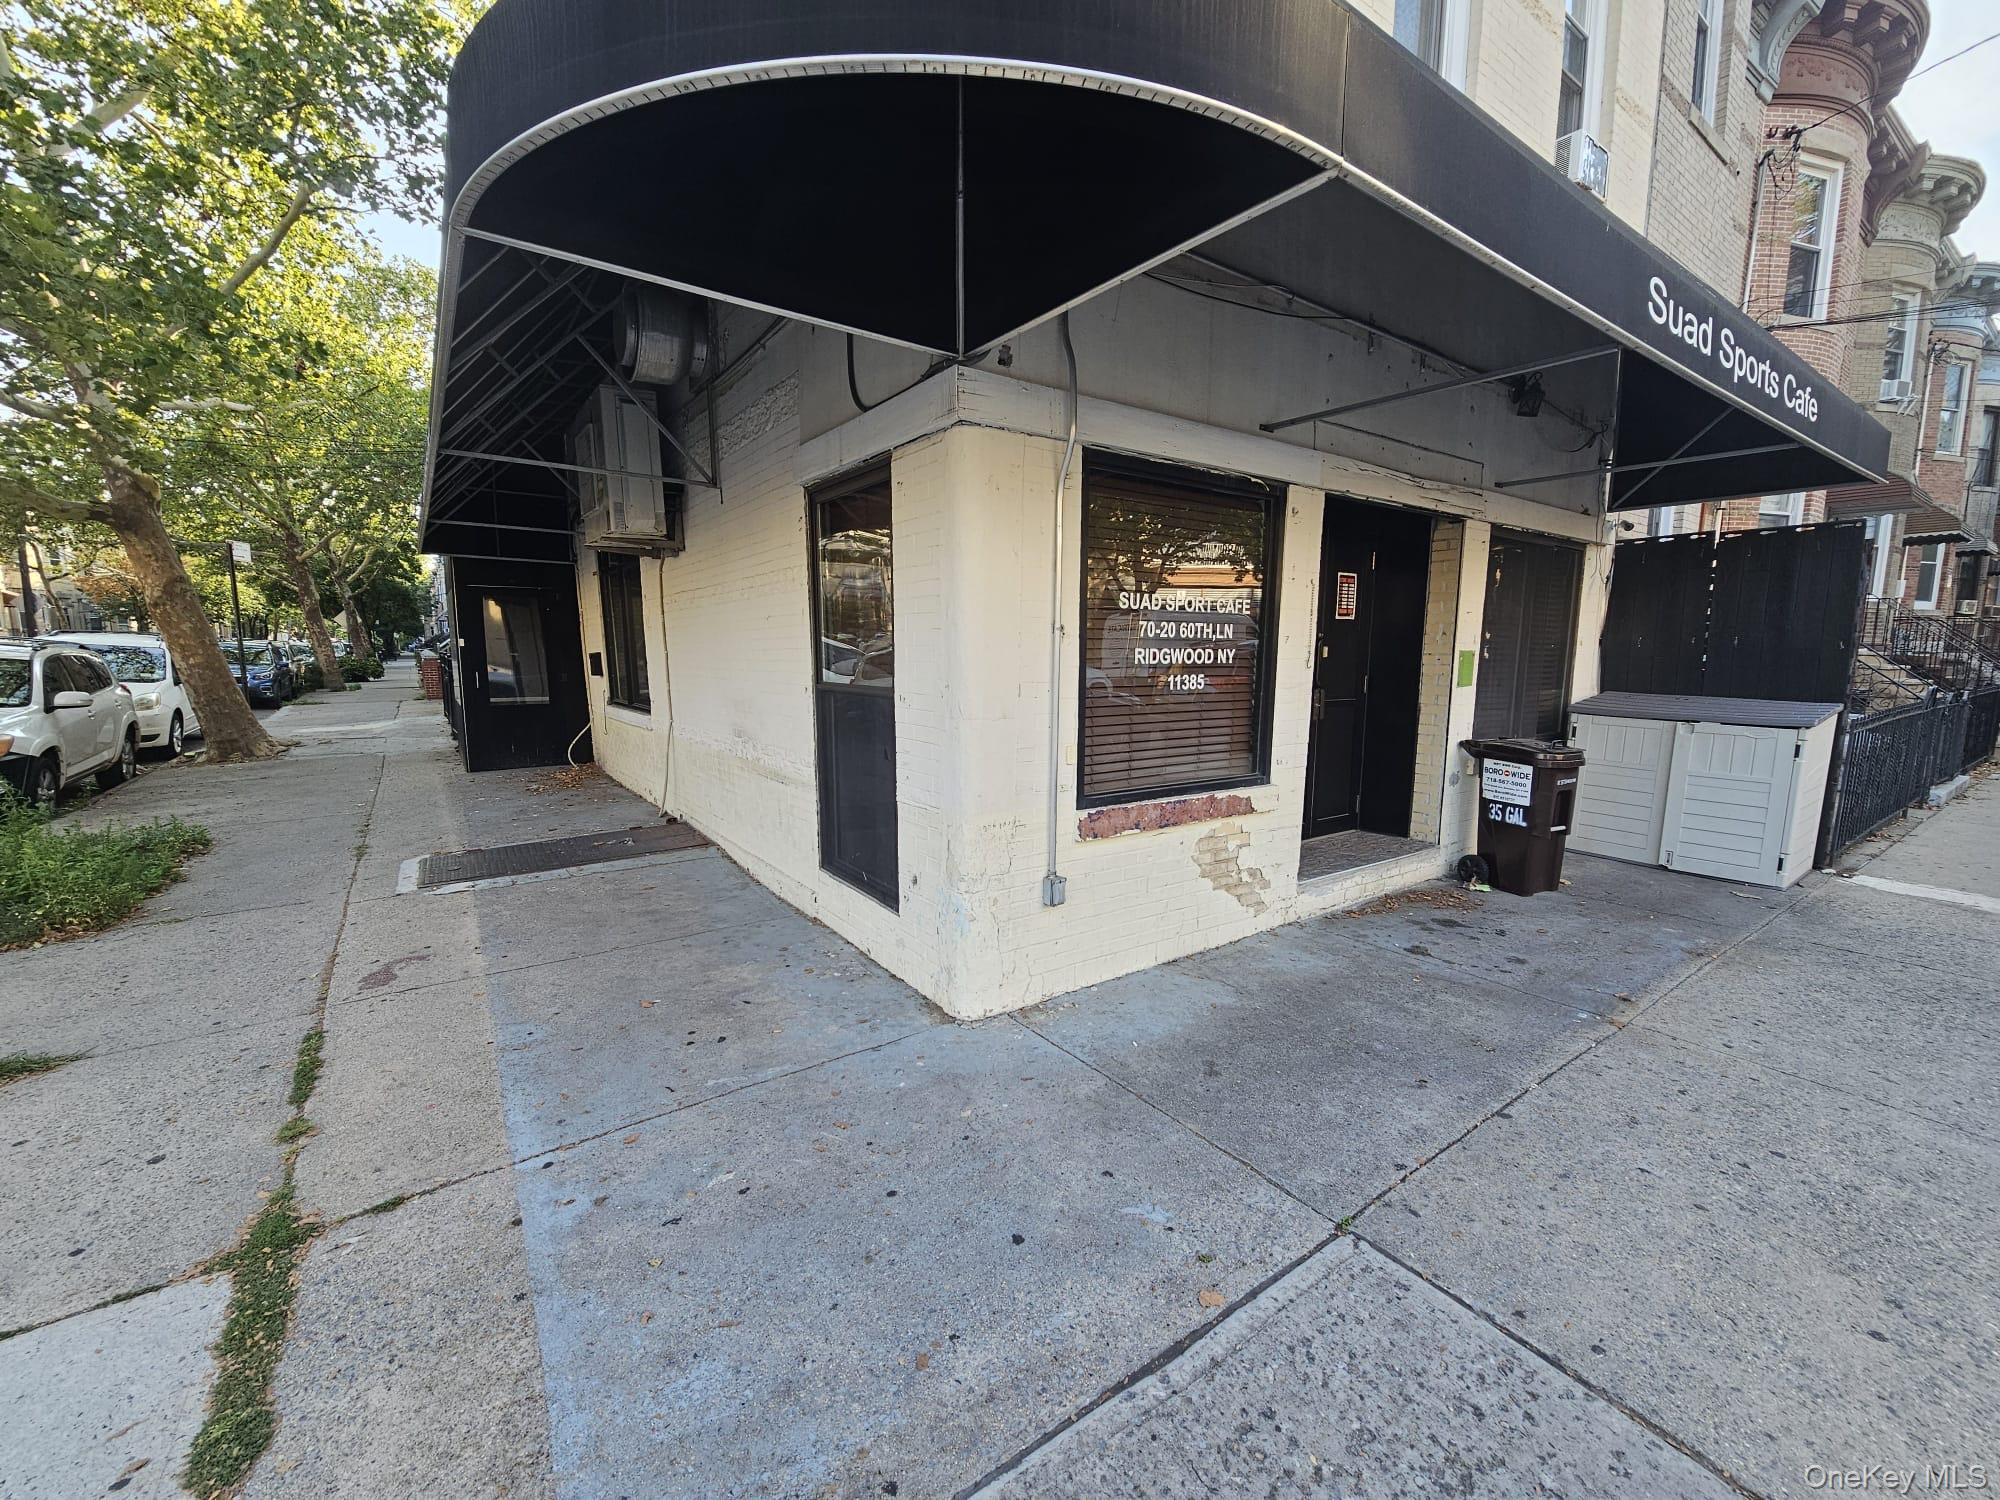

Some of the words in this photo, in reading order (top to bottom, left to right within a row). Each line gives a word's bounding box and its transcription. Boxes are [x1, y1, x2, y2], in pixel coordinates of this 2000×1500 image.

[1648, 277, 1713, 356] Suad
[1719, 328, 1780, 399] Sports
[1783, 374, 1818, 422] Cafe
[1119, 591, 1162, 611] SUAD
[1165, 594, 1213, 613] SPORT
[1216, 599, 1251, 615] CAFE
[1138, 621, 1176, 638] 70-20
[1134, 648, 1214, 665] RIDGWOOD
[1217, 648, 1236, 665] NY
[1167, 674, 1205, 690] 11385
[1488, 803, 1503, 821] 35
